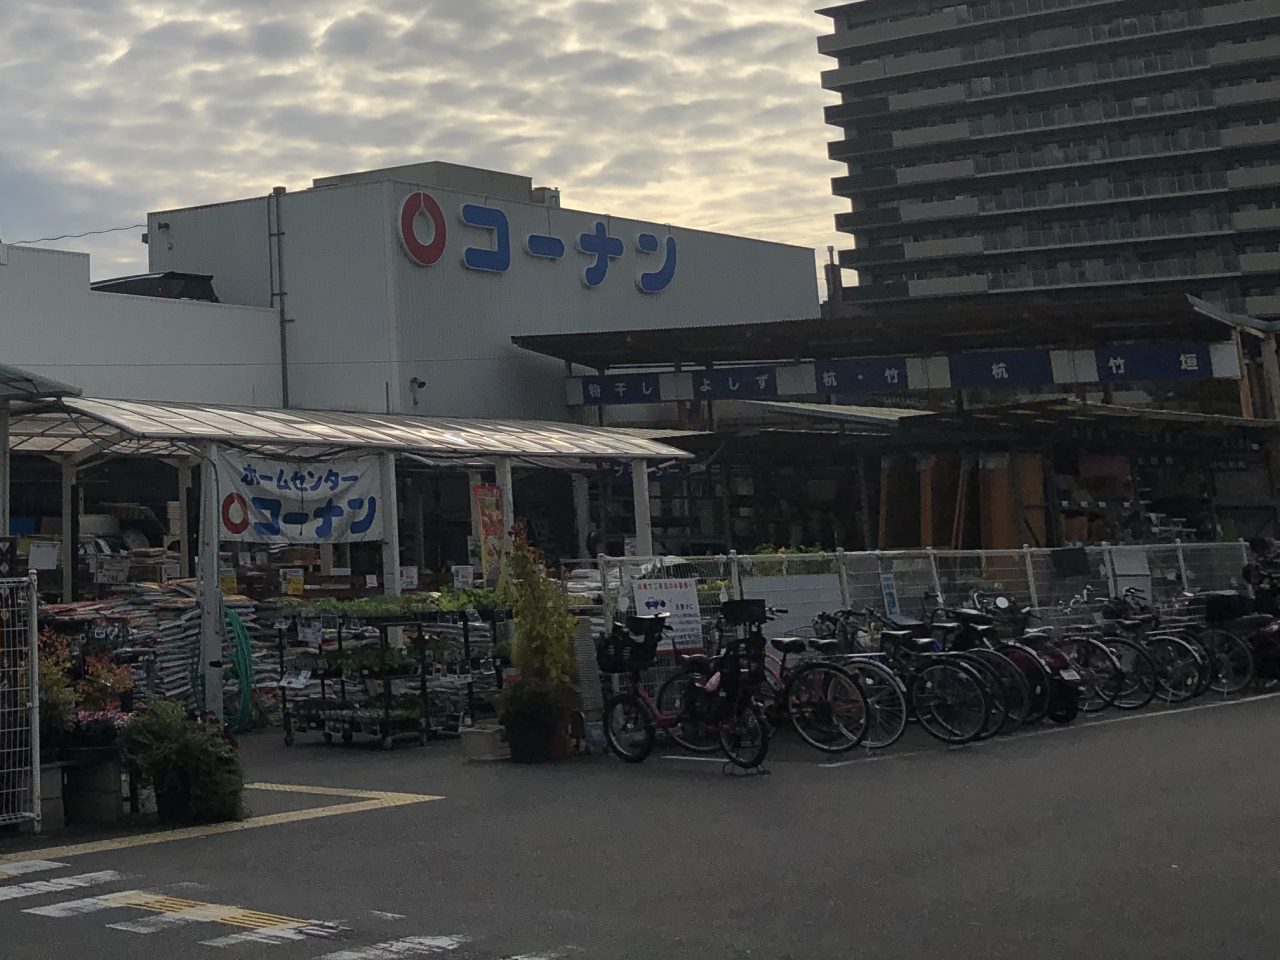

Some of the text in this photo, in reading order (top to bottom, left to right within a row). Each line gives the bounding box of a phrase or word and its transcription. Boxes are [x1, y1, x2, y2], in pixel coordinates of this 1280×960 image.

[461, 203, 677, 292] コーナン
[699, 374, 769, 392] よしず
[991, 362, 1009, 380] 杭
[241, 464, 358, 492] ホームセンター
[251, 496, 377, 538] コーナン
